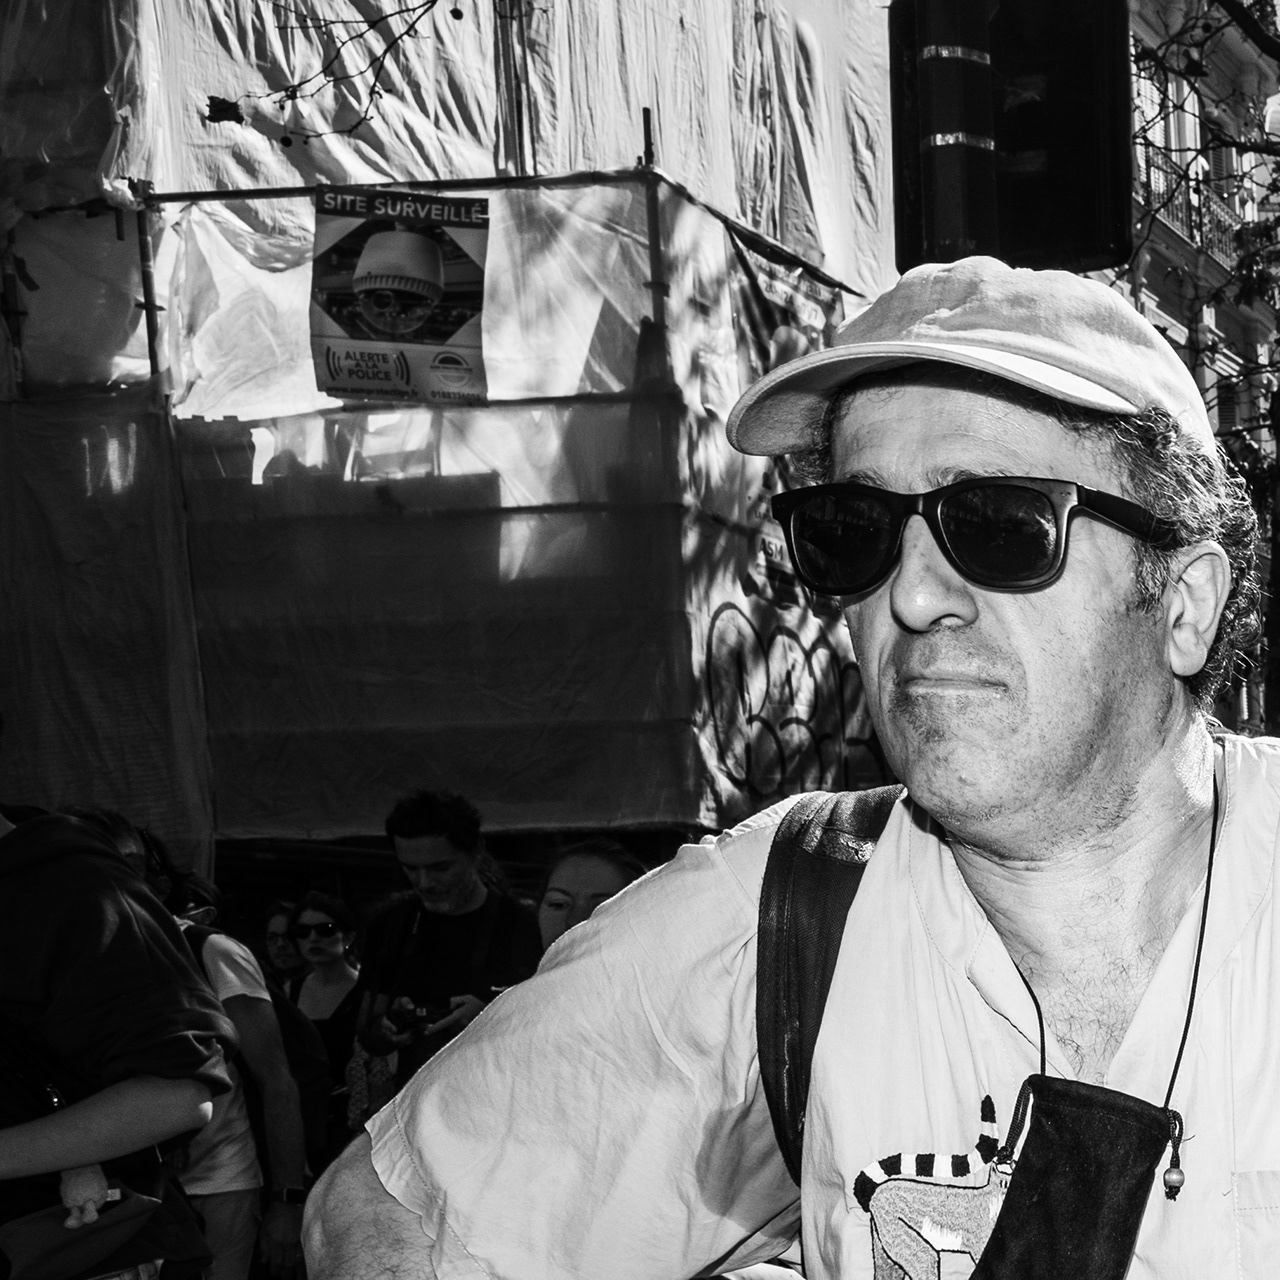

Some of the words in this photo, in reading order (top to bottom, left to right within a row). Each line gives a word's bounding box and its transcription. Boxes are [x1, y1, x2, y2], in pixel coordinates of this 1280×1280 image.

[324, 193, 368, 213] SITE
[374, 198, 483, 223] SURVEILLÉ
[344, 351, 390, 364] ALERTE
[347, 368, 392, 381] POLICE
